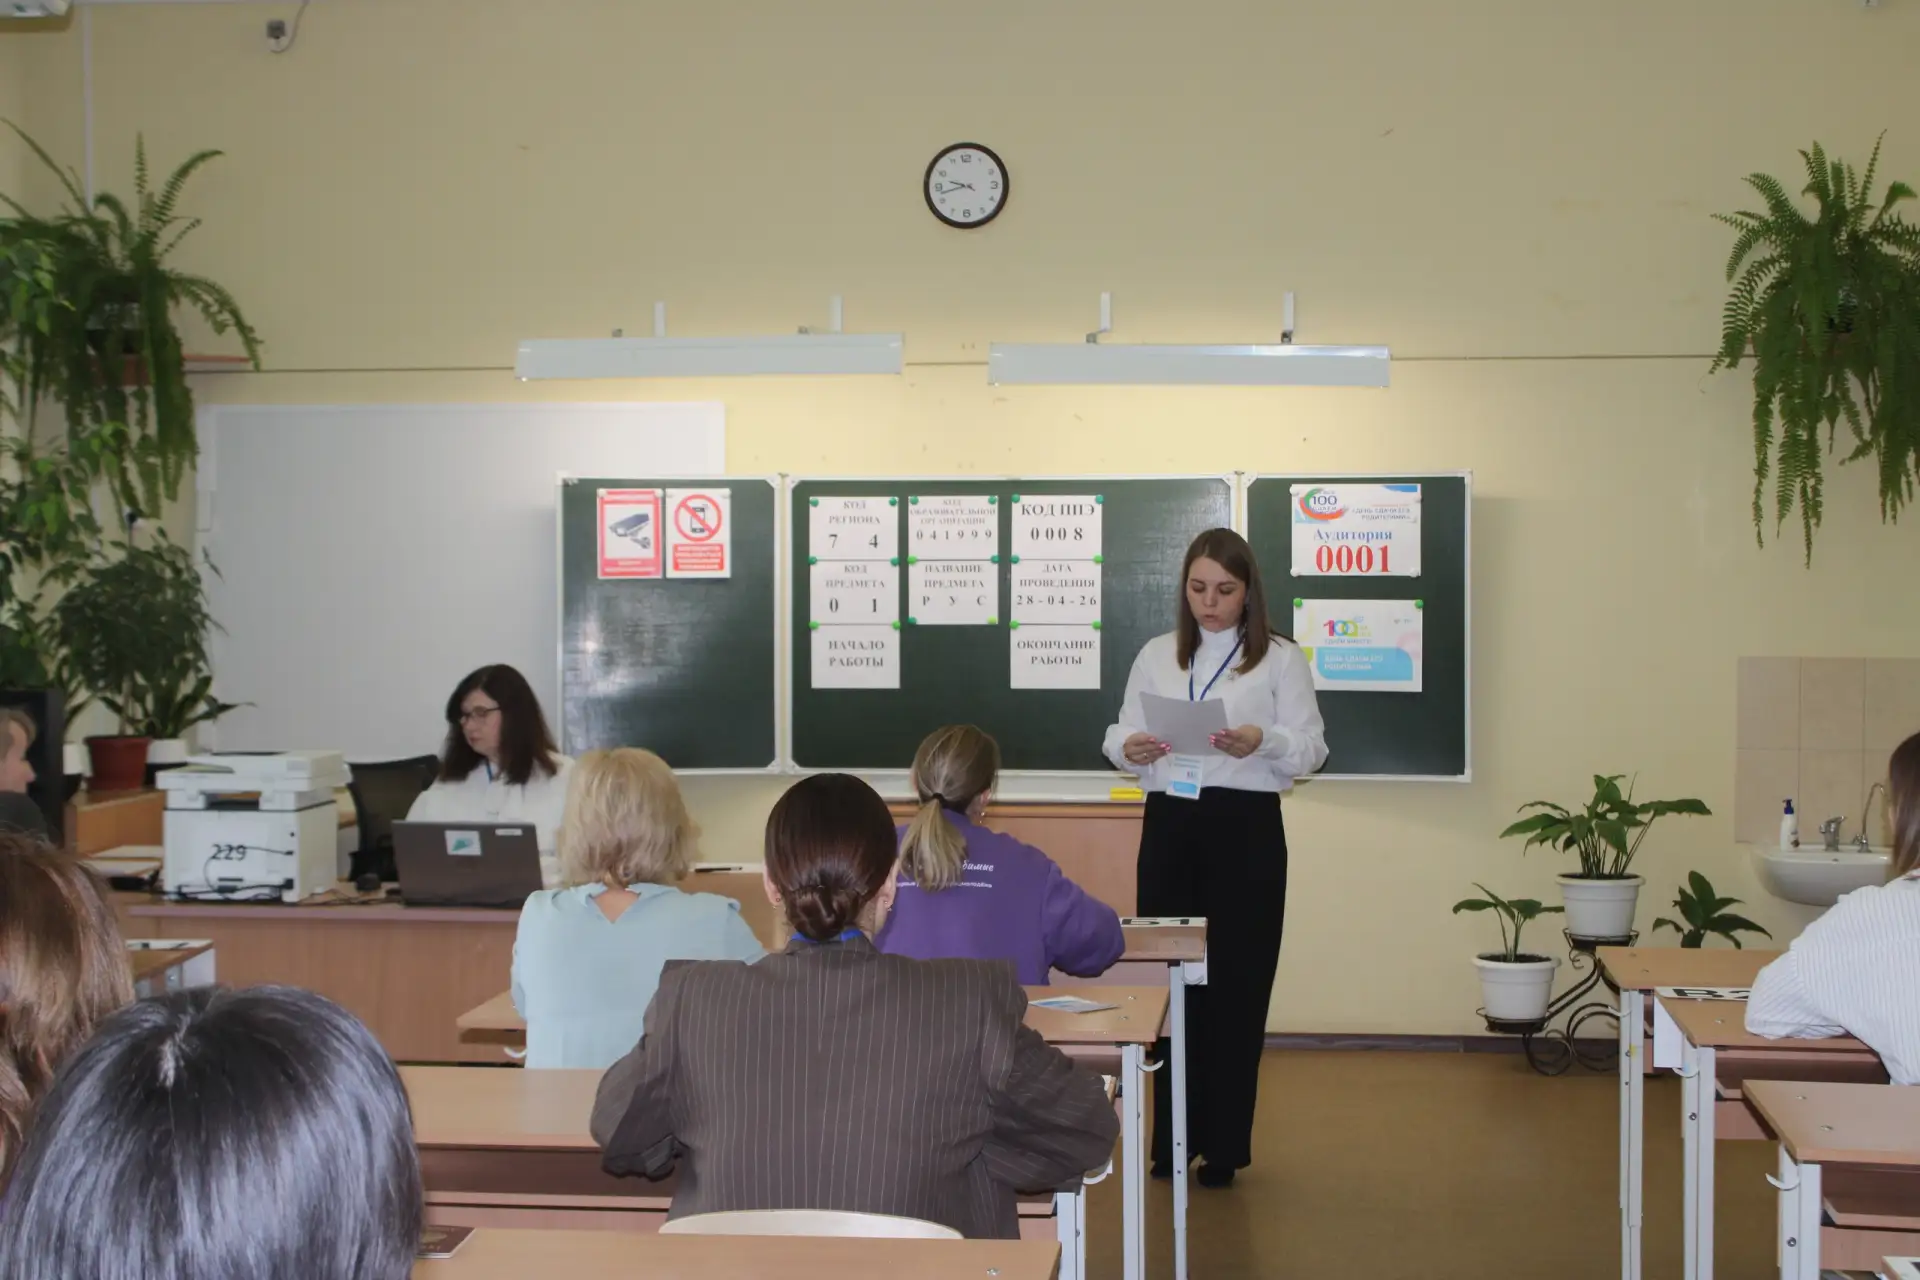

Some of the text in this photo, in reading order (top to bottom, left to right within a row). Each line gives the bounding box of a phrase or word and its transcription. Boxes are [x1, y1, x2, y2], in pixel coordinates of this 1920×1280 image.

[960, 154, 972, 163] 12
[935, 183, 943, 192] 9
[990, 181, 998, 189] 3
[962, 209, 971, 218] 6
[843, 500, 866, 509] КОД
[1312, 495, 1337, 506] 100
[1022, 504, 1095, 517] КОД ППЭ
[829, 515, 881, 524] РЕГИОНА
[1314, 529, 1392, 543] Аудитория
[1316, 545, 1391, 573] 0001
[844, 565, 867, 574] КОД
[925, 564, 983, 573] НАЗВАНИЕ
[1042, 564, 1072, 573] ДАТА
[826, 579, 885, 588] ПРЕДМЕТА
[924, 579, 984, 588] ПРЕДМЕТА
[1020, 579, 1095, 588] ПРОВЕДЕНИЯ
[829, 640, 884, 650] НАЧАЛО
[1017, 640, 1095, 649] ОКОНЧАНИЕ
[829, 656, 883, 667] РАБОТЫ
[1031, 655, 1082, 665] РАБОТЫ
[211, 844, 247, 861] 229
[962, 860, 994, 872] бимые
